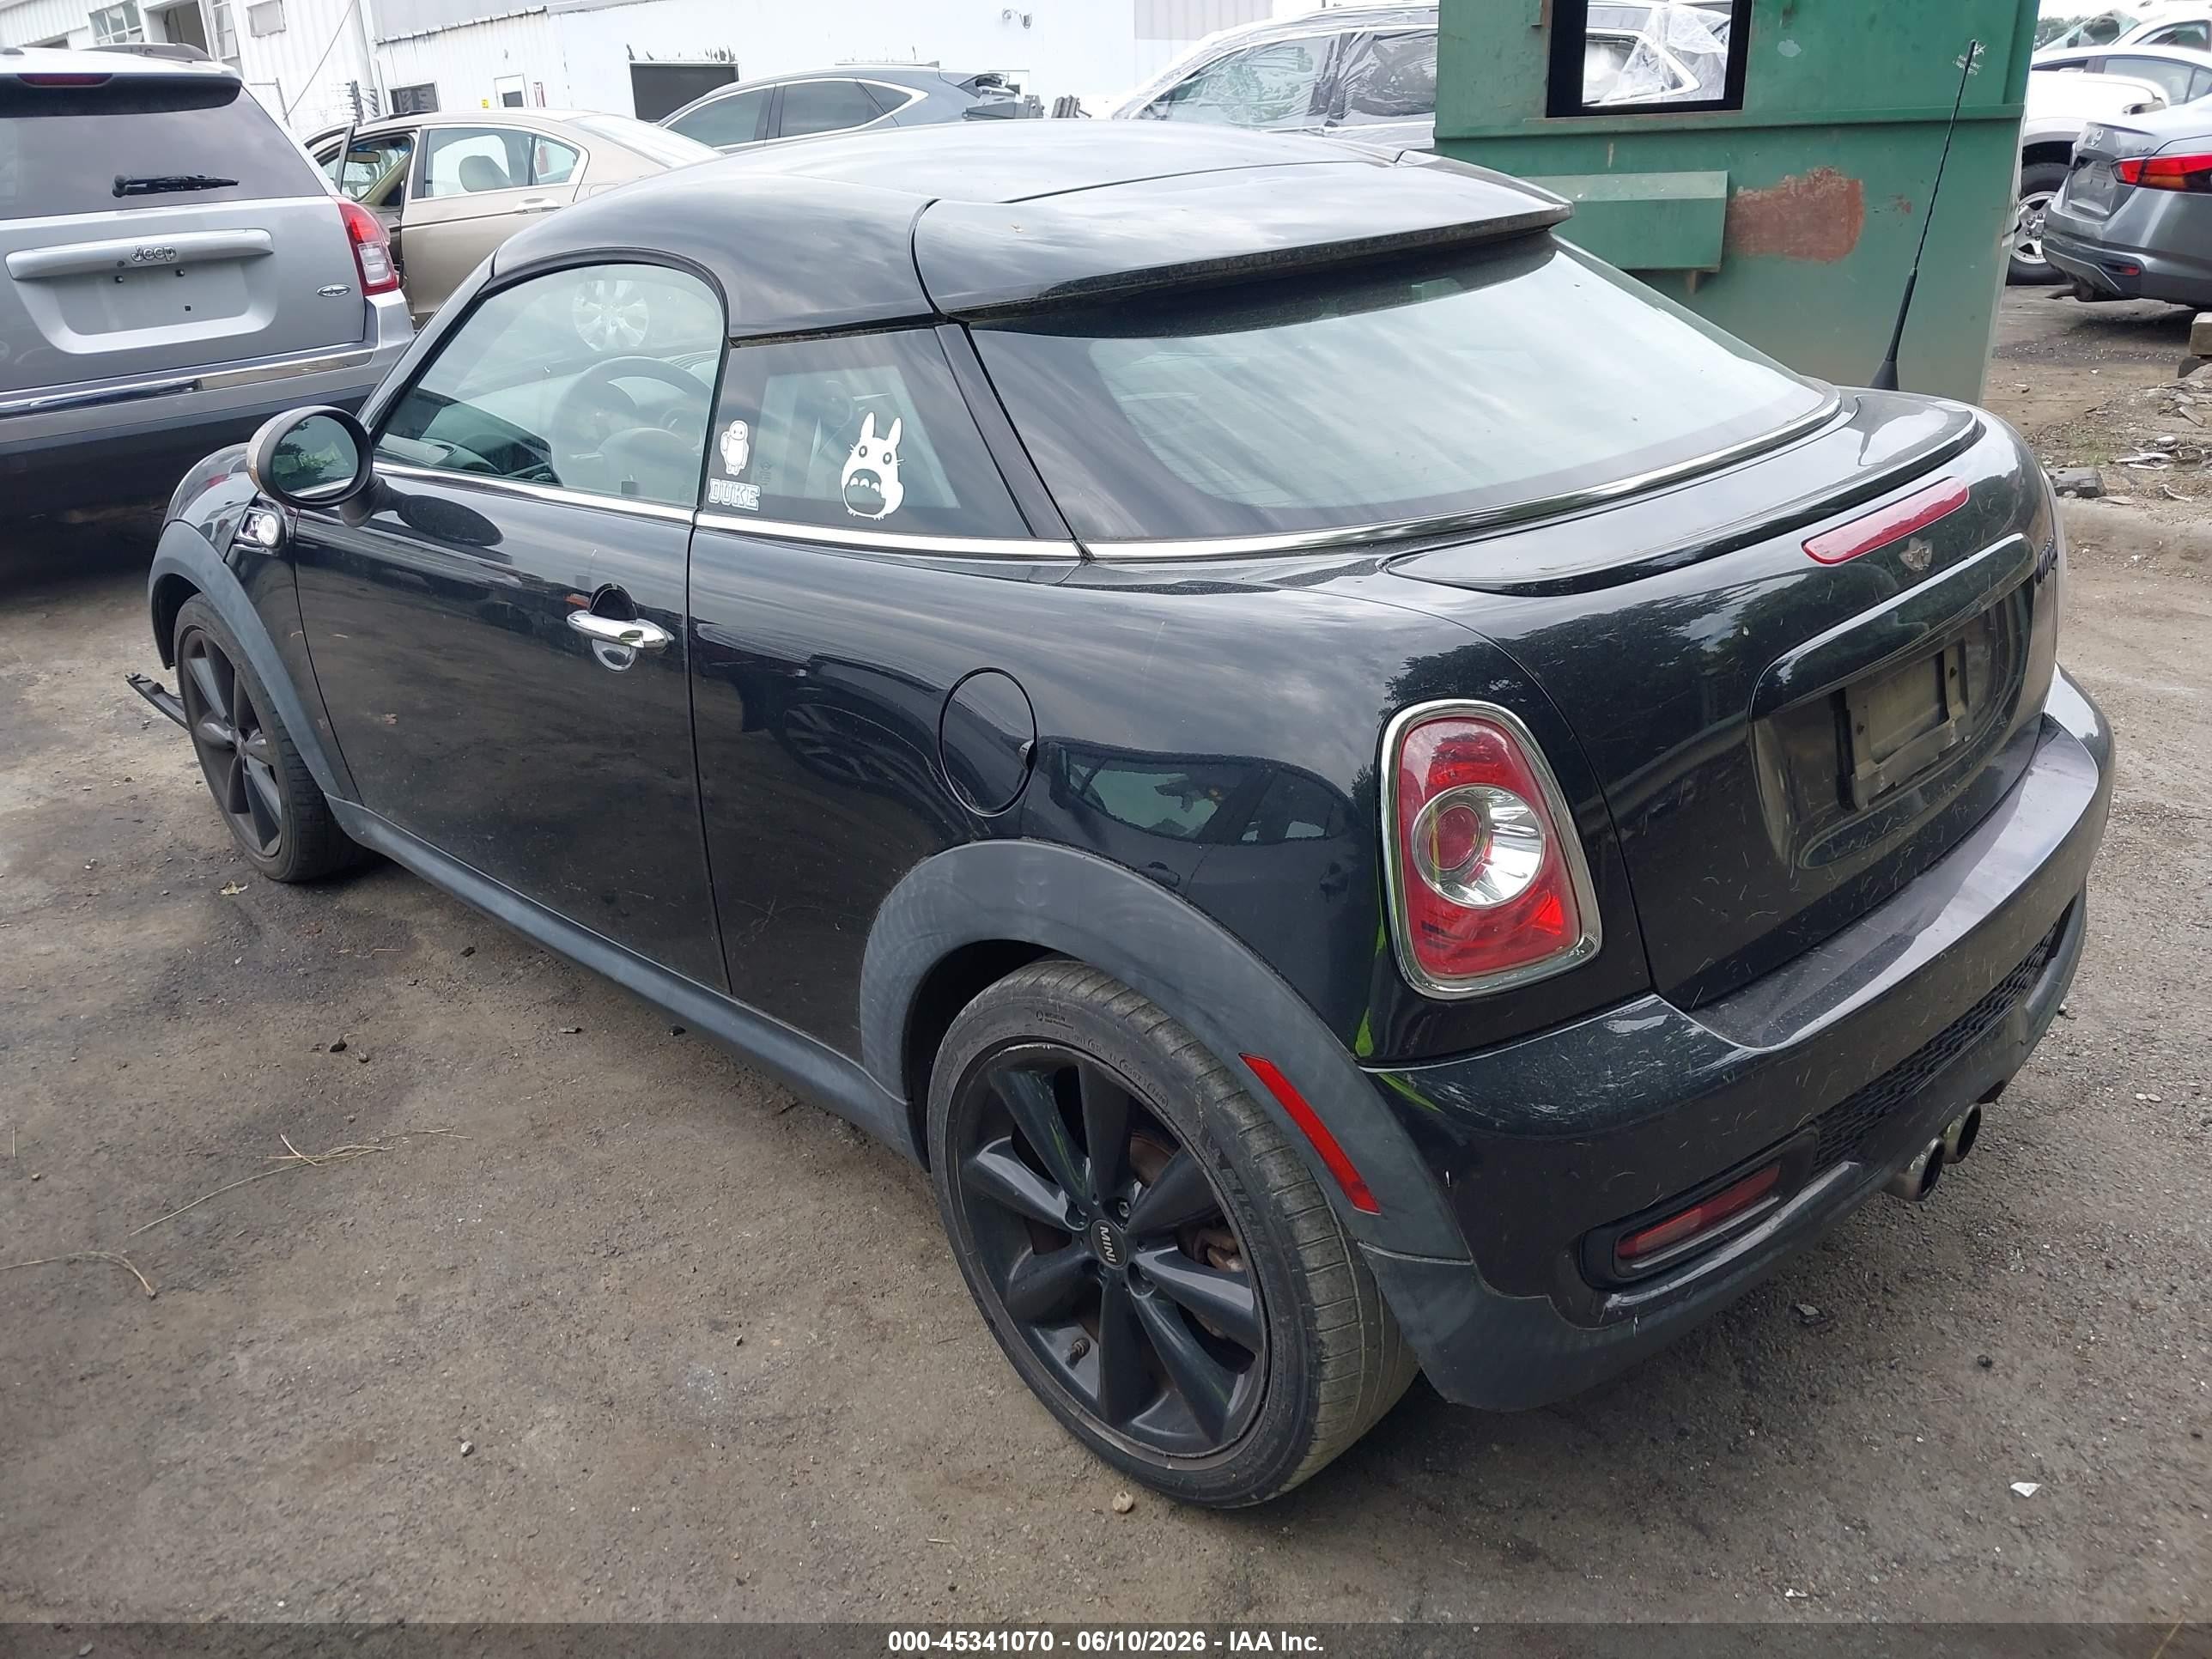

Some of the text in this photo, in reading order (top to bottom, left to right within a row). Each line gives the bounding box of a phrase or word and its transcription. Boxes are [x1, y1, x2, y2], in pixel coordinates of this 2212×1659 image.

[131, 246, 177, 262] Jeep
[708, 478, 760, 511] DUKE
[1099, 1225, 1117, 1263] MINI
